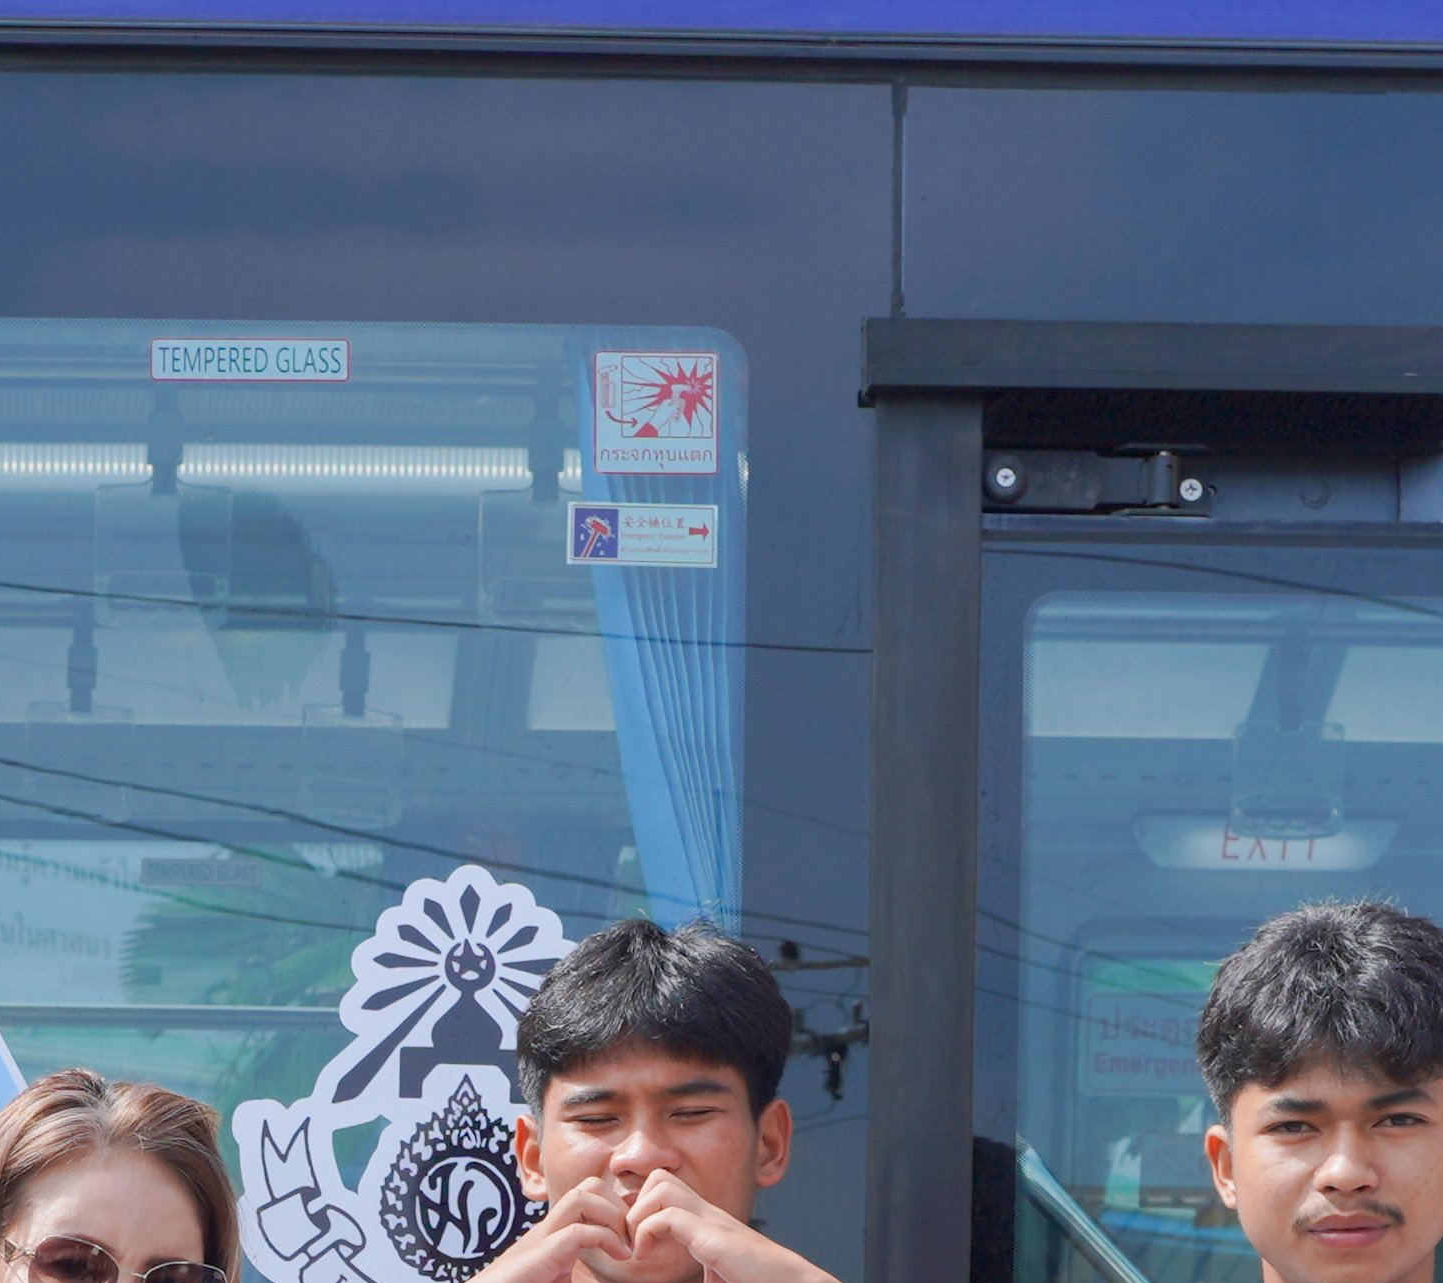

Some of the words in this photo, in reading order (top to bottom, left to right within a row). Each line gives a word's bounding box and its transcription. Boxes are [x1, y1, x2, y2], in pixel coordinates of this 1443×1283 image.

[158, 345, 269, 375] TEMPERED
[275, 346, 343, 376] GLASS
[600, 447, 713, 470] กระจกทุบแตก
